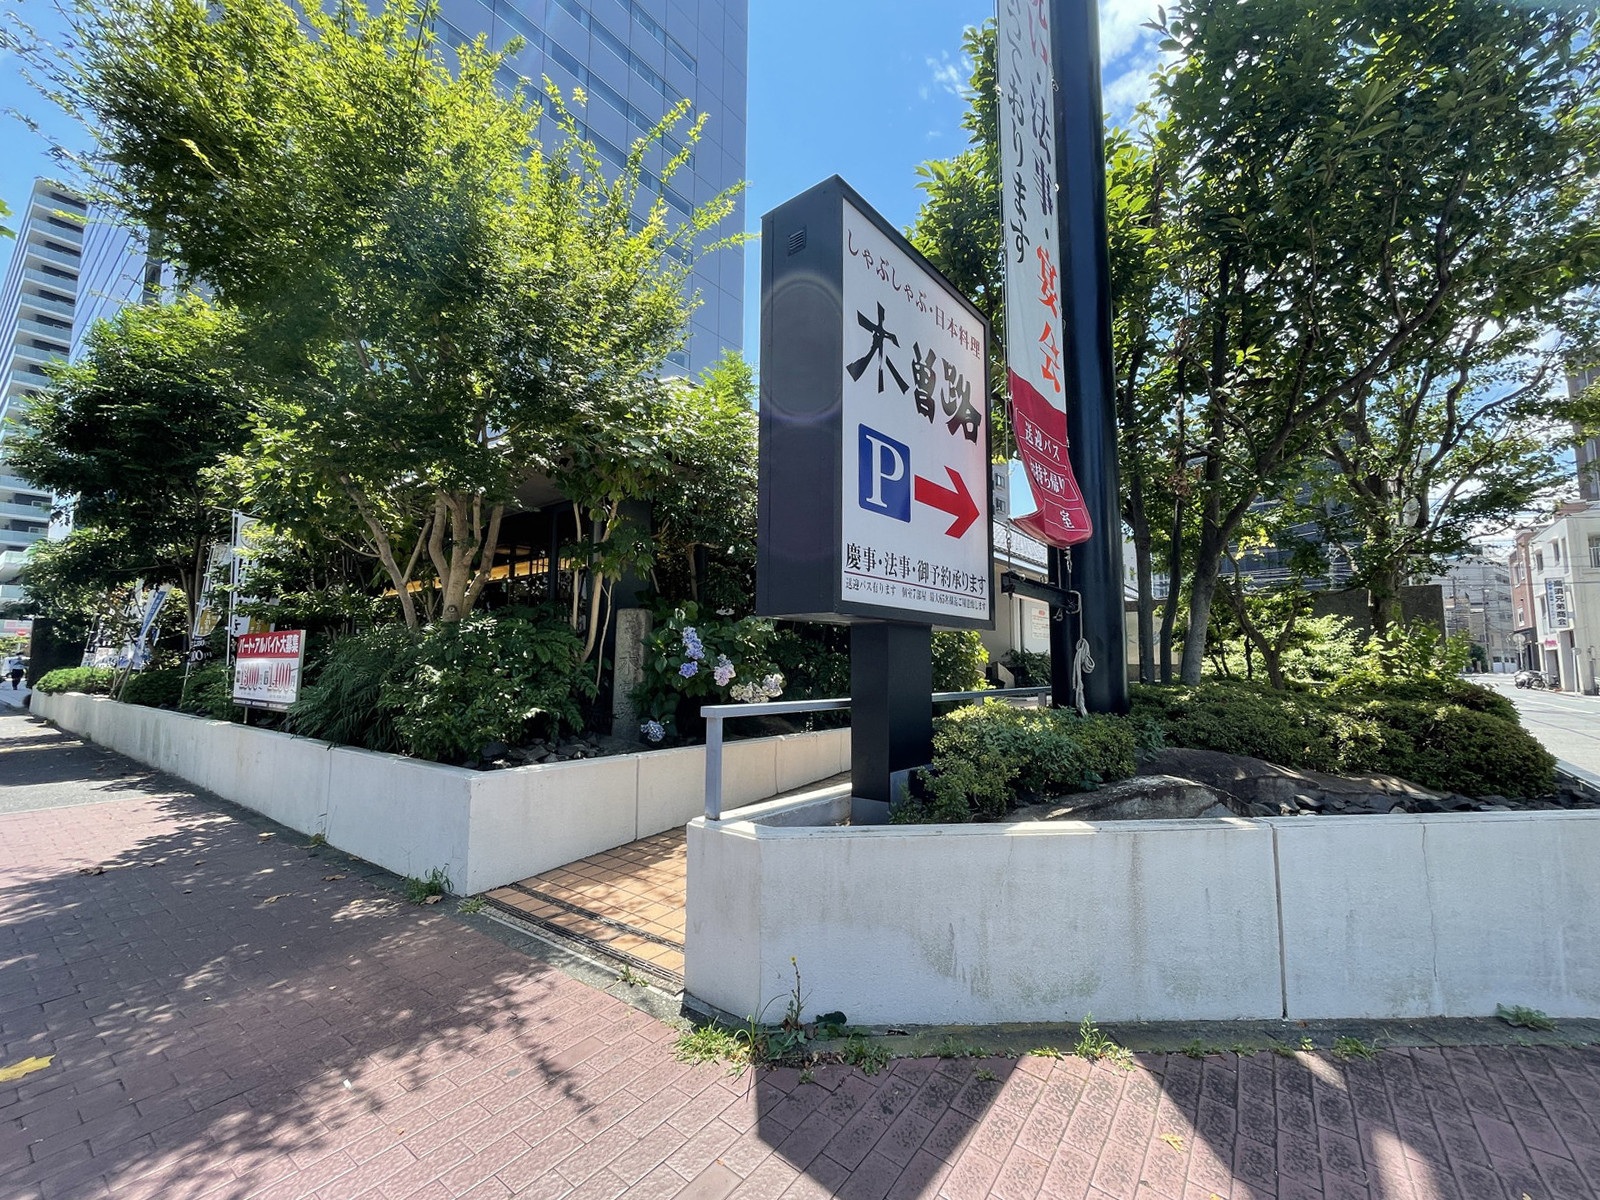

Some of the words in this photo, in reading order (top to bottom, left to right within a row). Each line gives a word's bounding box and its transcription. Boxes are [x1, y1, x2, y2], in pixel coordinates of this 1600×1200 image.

[848, 228, 981, 360] しゃぶしゃぶ・日本料理
[846, 300, 982, 446] 木曽路
[866, 434, 905, 508] P
[1025, 420, 1060, 461] 送迎バス
[846, 542, 986, 596] 慶事・法事・御予約承ります
[238, 634, 299, 653] パート・アルバイト大募集
